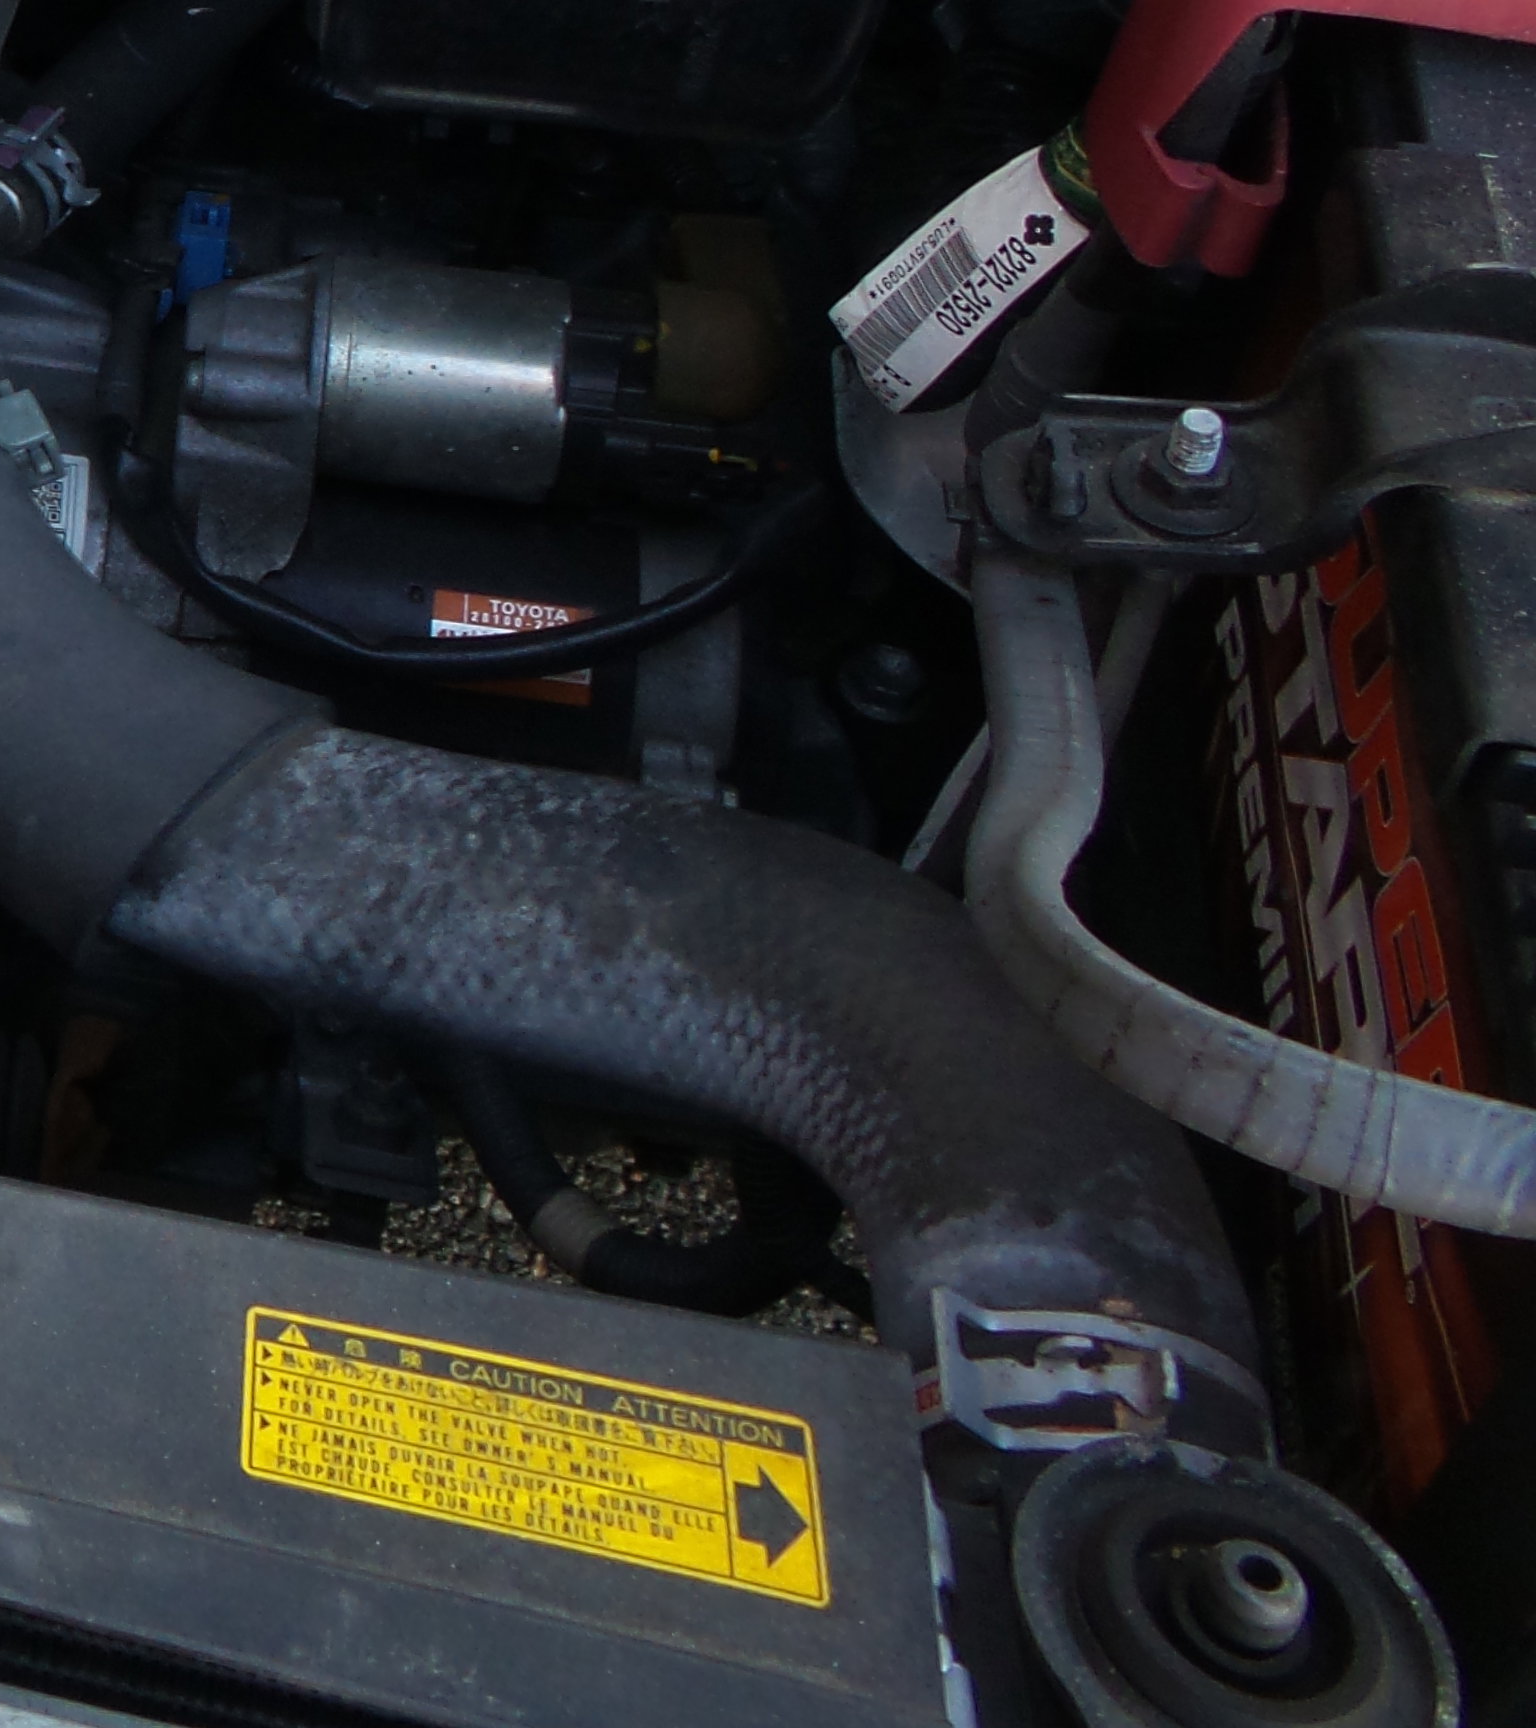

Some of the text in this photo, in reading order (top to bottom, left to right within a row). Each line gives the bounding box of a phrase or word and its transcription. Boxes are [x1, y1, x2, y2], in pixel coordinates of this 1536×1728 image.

[934, 235, 1038, 337] 82121-21520
[489, 599, 569, 623] TOYOTA
[279, 1378, 338, 1403] NEVER
[349, 1393, 396, 1415] OPEN
[408, 1407, 440, 1424] THE
[451, 1416, 508, 1441] VALVE
[521, 1430, 573, 1454] WHEN
[279, 1397, 315, 1416] FOR
[419, 1428, 451, 1448] SEE
[449, 1359, 785, 1448] CAUTION ATTENTION
[277, 1438, 310, 1458] EST
[412, 1467, 516, 1505] CONSULTER
[529, 1495, 548, 1515] LE
[561, 1502, 639, 1533] MANUEL
[650, 1523, 675, 1542] DU
[278, 1421, 718, 1533] NE JAMAIS OUVRIR LA SOUPAPE QUAND ELLE
[422, 1487, 471, 1512] POUR
[481, 1501, 514, 1522] LES
